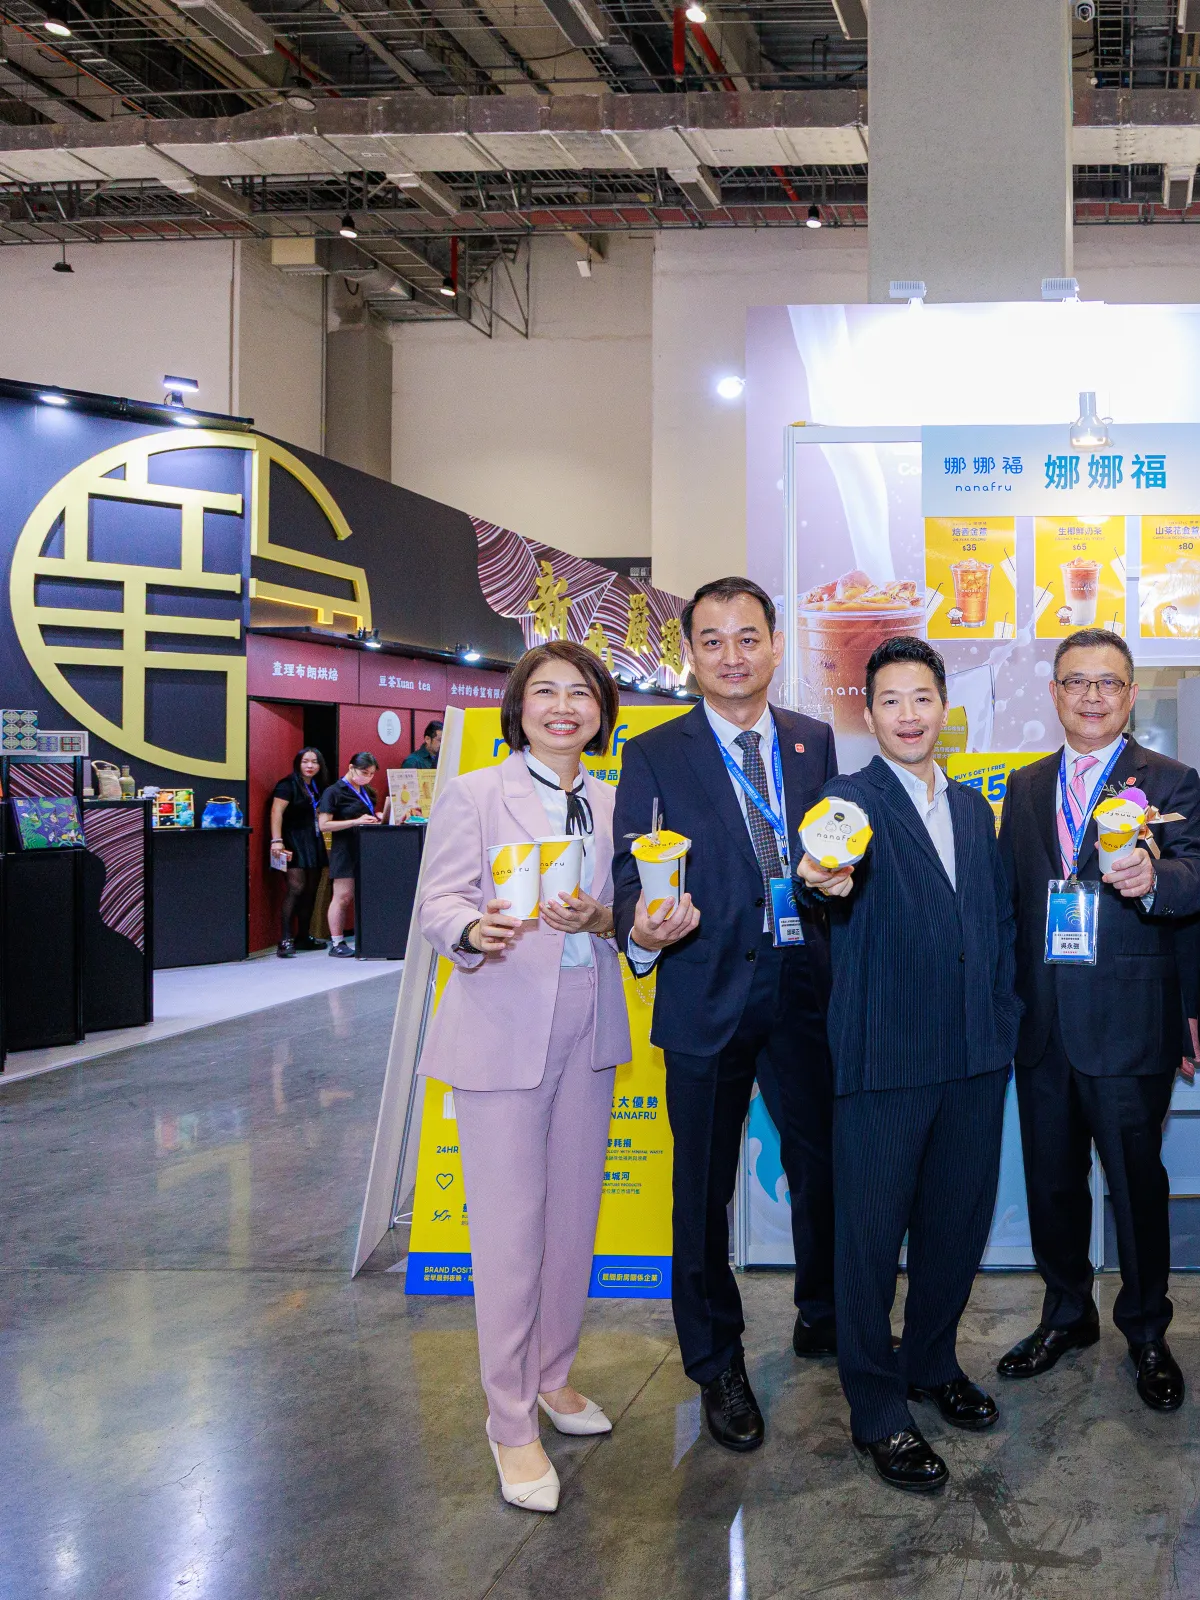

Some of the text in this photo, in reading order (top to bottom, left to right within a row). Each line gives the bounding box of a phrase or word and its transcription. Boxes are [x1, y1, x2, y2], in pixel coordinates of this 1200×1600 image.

[944, 456, 1023, 474] 娜娜福
[1044, 454, 1167, 490] 娜娜福
[955, 481, 1012, 492] nanafru
[963, 543, 977, 551] $35
[1072, 543, 1087, 551] $65
[1179, 542, 1194, 550] $80
[272, 661, 339, 681] 查理布朗烘焙
[418, 680, 431, 692] tea
[954, 773, 967, 781] BUY
[974, 768, 986, 776] GET
[991, 763, 1006, 771] FREE
[817, 833, 857, 842] nanafru
[436, 1145, 459, 1154] 24HR
